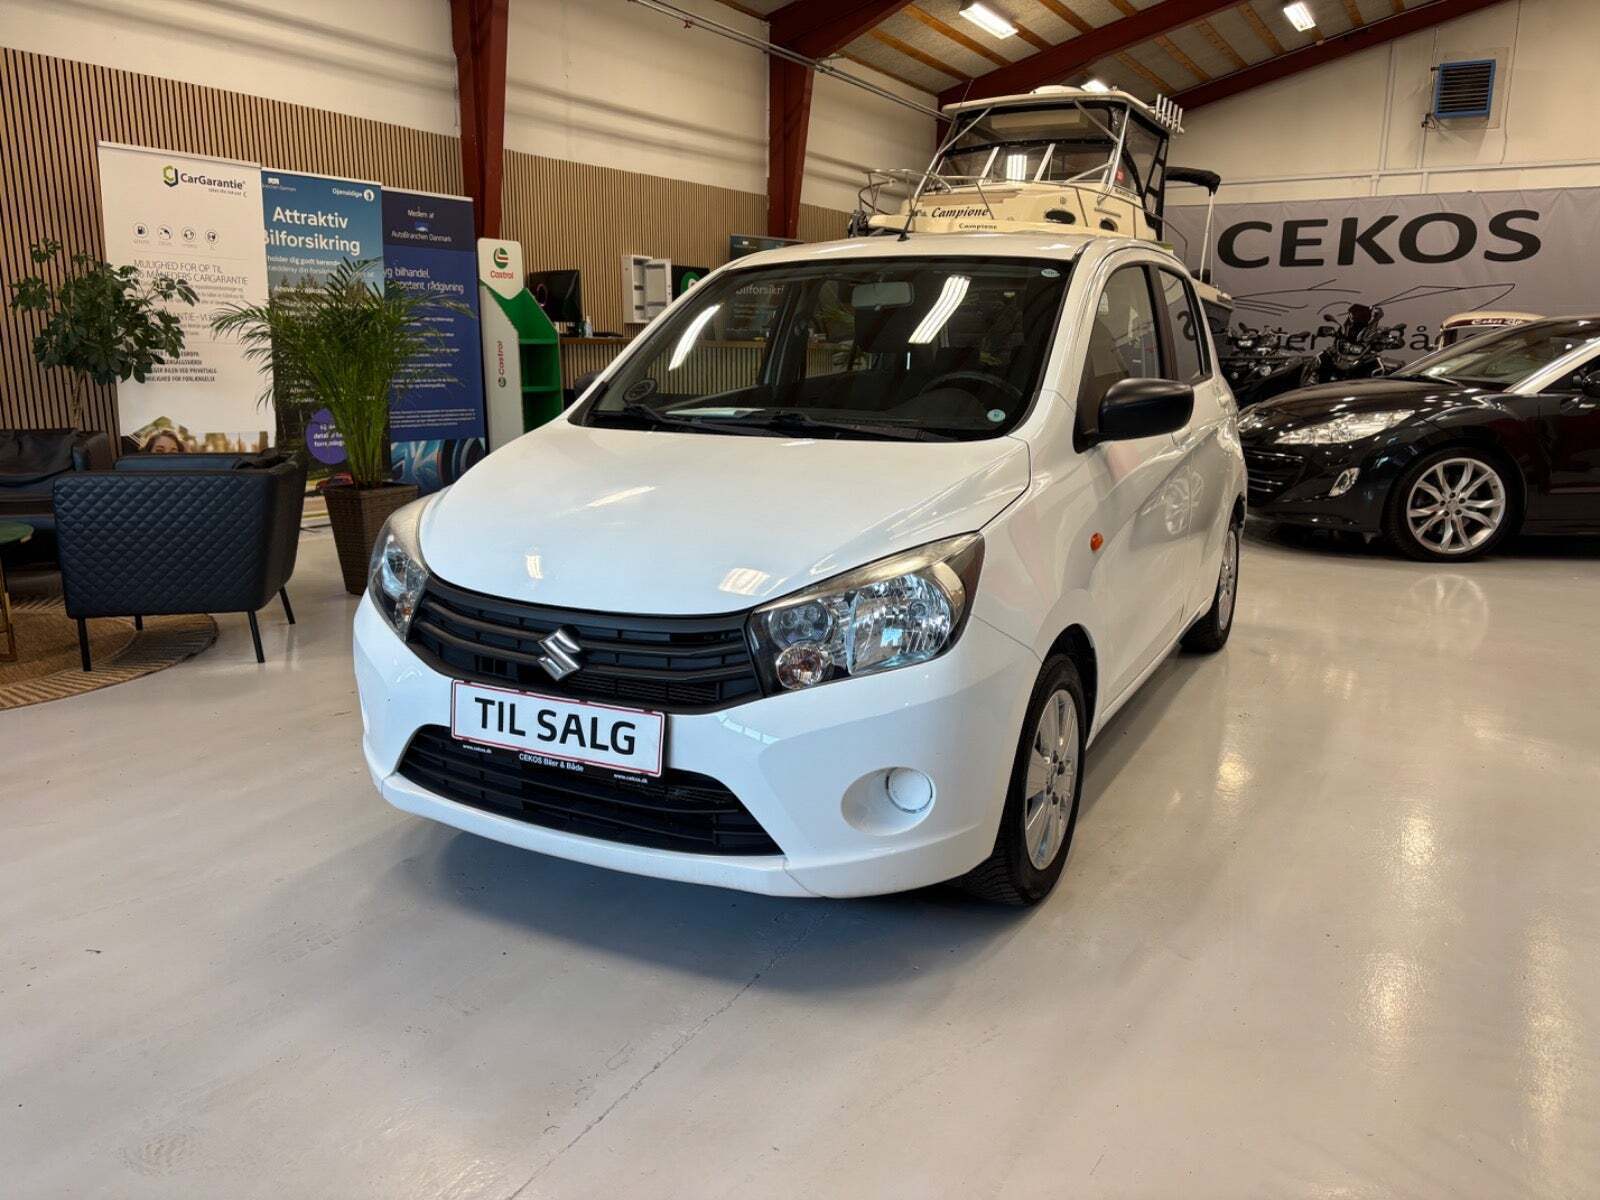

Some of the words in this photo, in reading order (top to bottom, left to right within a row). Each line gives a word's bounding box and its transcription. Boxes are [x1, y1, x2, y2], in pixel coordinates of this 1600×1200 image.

[180, 173, 243, 189] CarGarantie
[272, 206, 349, 229] Attraktiv
[931, 206, 990, 219] Campione
[1216, 208, 1542, 269] CEKOS
[490, 270, 514, 279] Castrol
[474, 697, 526, 737] TIL
[537, 708, 636, 755] SALG
[519, 752, 543, 765] CEKOS
[566, 761, 584, 773] Både
